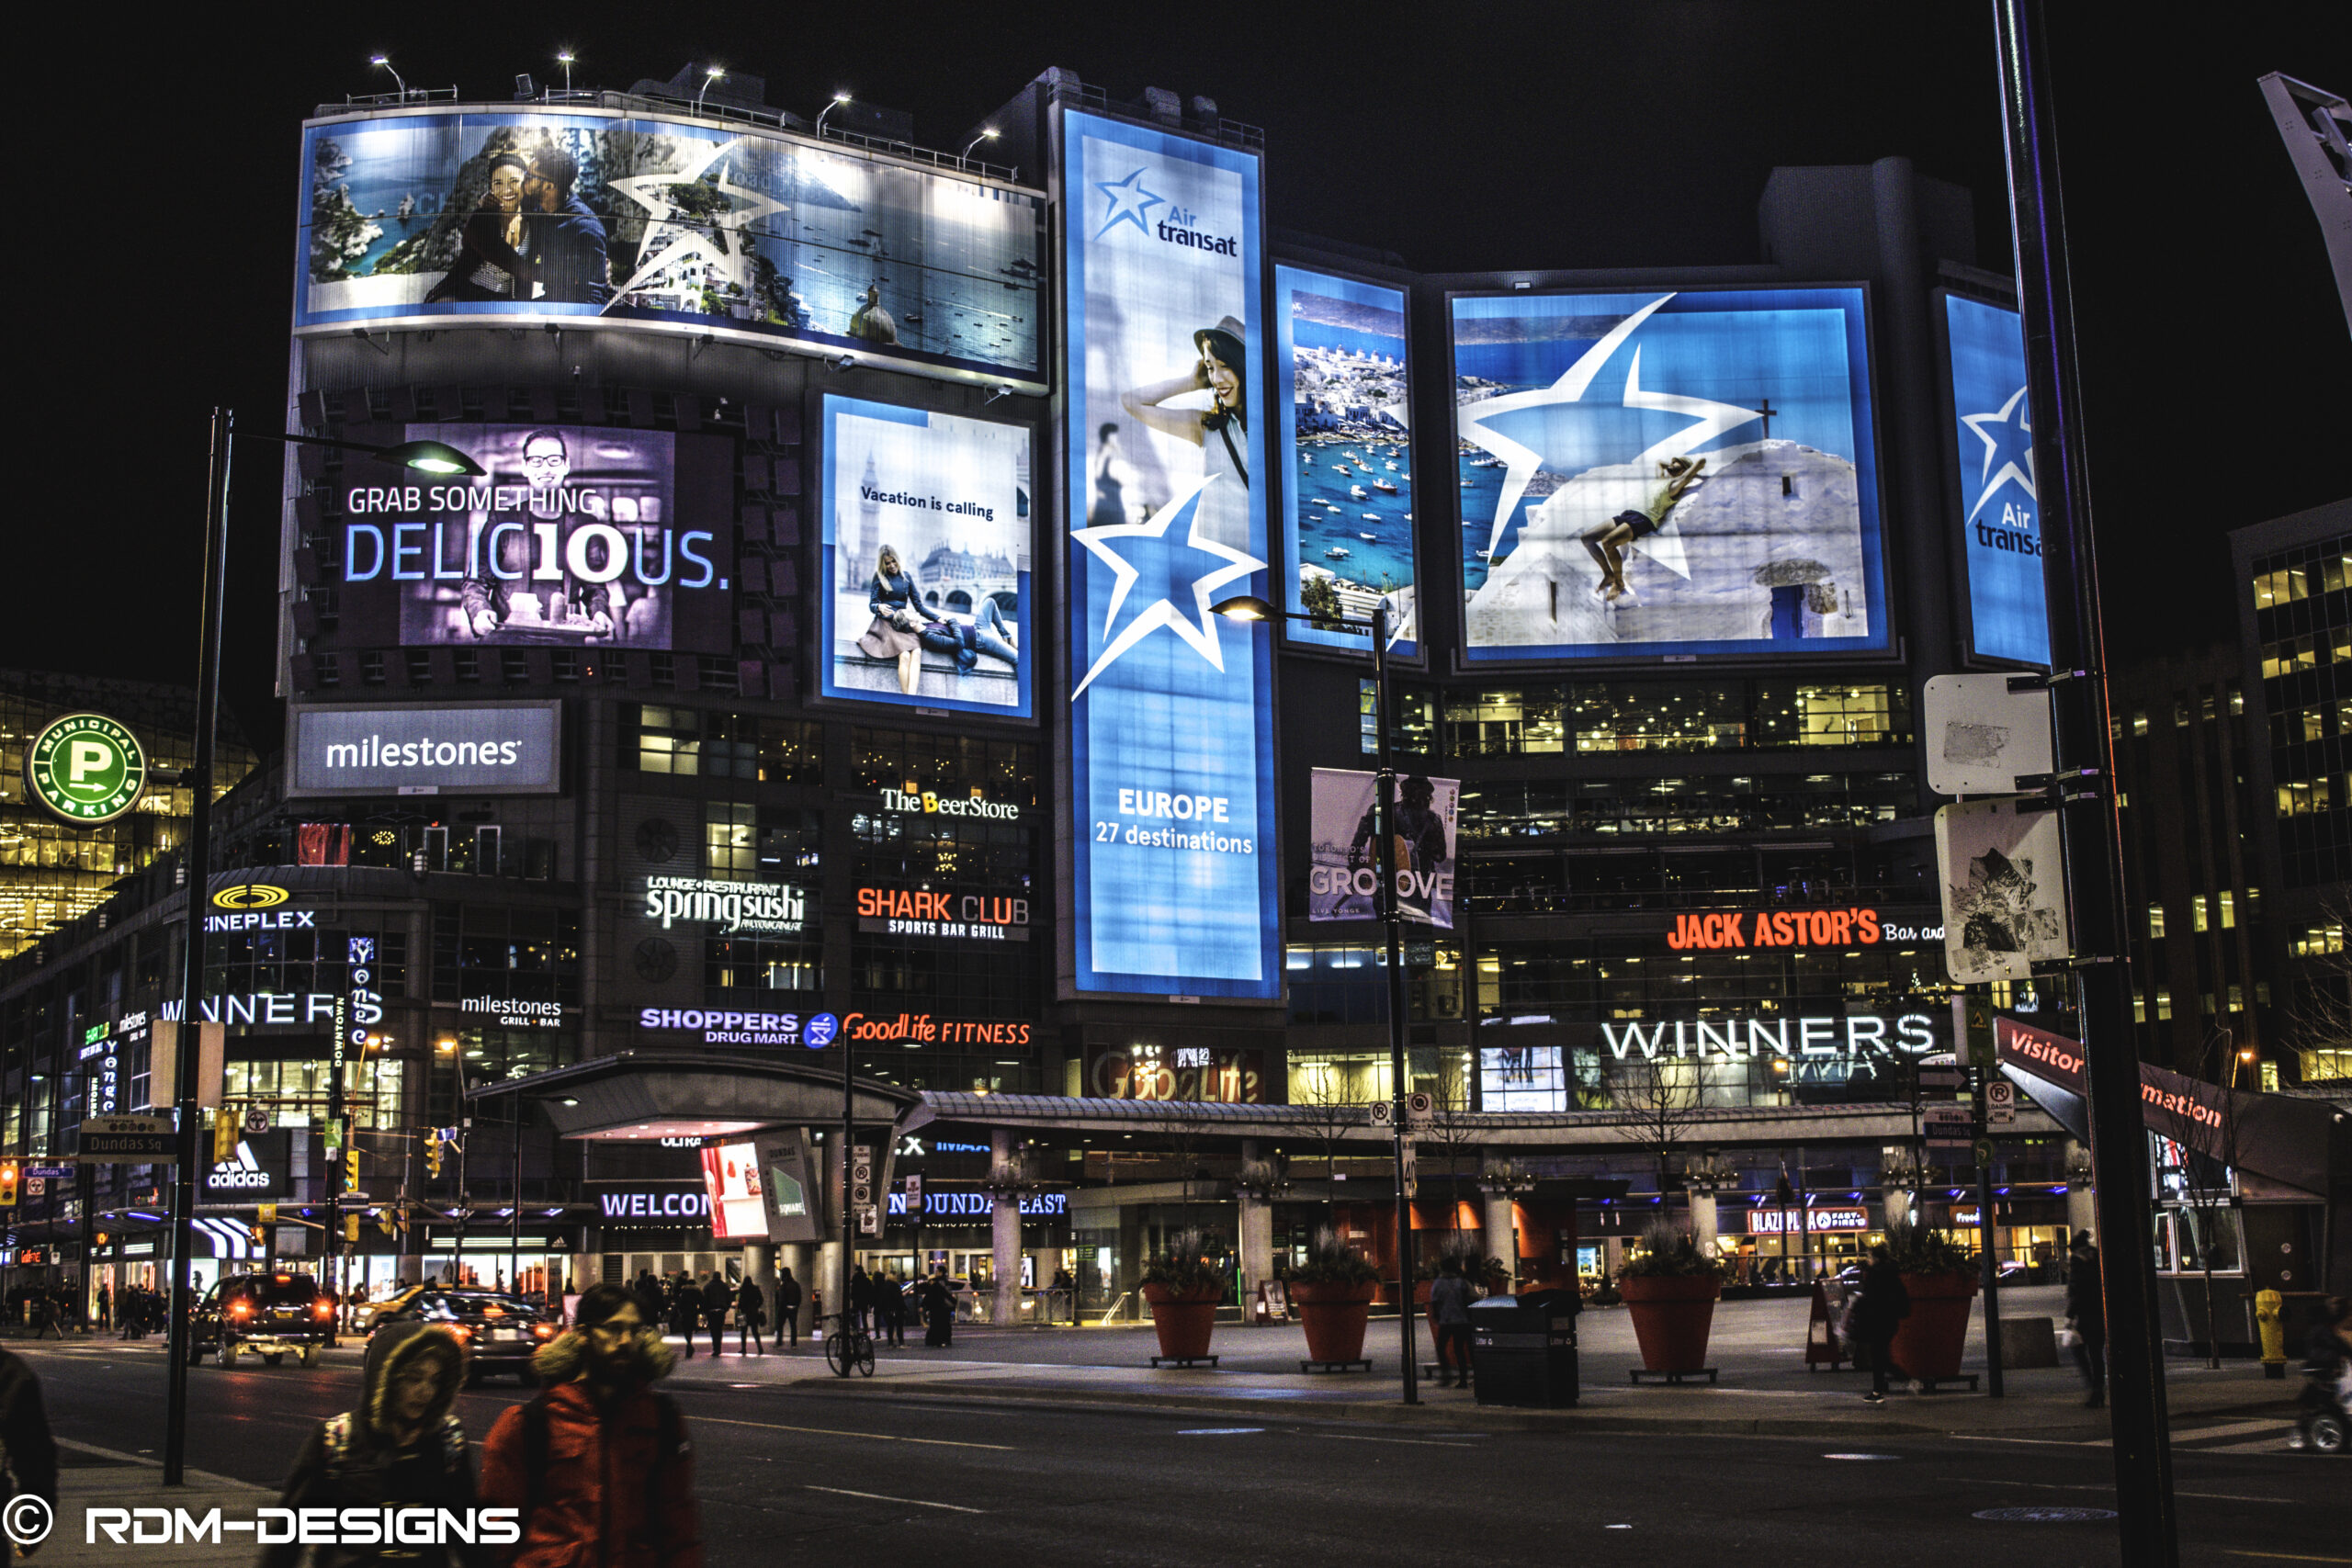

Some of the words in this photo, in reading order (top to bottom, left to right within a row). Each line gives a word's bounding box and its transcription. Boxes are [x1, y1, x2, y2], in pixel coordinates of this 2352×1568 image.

[1168, 205, 1197, 228] Air
[1157, 220, 1238, 258] transat
[348, 486, 422, 513] GRAB
[429, 486, 599, 514] SOMETHING
[861, 486, 927, 509] Vacation
[931, 496, 943, 511] is
[946, 502, 994, 522] calling
[2001, 502, 2030, 529] Air
[1975, 518, 2042, 558] transa
[40, 719, 136, 761] MUNICIPAL
[325, 735, 518, 770] milestones
[70, 740, 113, 782] P
[38, 772, 138, 816] PARKING
[1118, 787, 1230, 824] EUROPE
[1095, 821, 1120, 843] 27
[1125, 825, 1253, 855] destinations
[647, 874, 697, 891] LOUNGE
[703, 879, 781, 897] RESTAURANT
[1309, 867, 1454, 901] GROOVE
[857, 887, 953, 921] SHARK
[961, 895, 1030, 926] CLUB
[888, 919, 936, 936] SPORTS
[940, 921, 967, 937] BAR
[970, 923, 1006, 940] GRILL
[1667, 912, 1746, 950] JACK
[1753, 907, 1880, 947] ASTOR'S
[1882, 923, 1917, 942] Bar
[162, 993, 383, 1026] WNNERS
[460, 994, 562, 1016] milestones
[500, 1016, 530, 1026] GRILL
[539, 1018, 560, 1027] BAR
[639, 1008, 799, 1032] SHOPPERS
[334, 997, 345, 1067] DOWNTOWN
[706, 1031, 752, 1044] DRUG
[753, 1032, 799, 1045] MART
[941, 1021, 1031, 1045] FITNESS
[1600, 1013, 1935, 1060] WINNERS
[2011, 1028, 2085, 1074] Visitor
[2140, 1082, 2222, 1128] mation
[91, 1136, 144, 1150] Dundas
[145, 1138, 162, 1151] Sq
[207, 1169, 270, 1189] adidas
